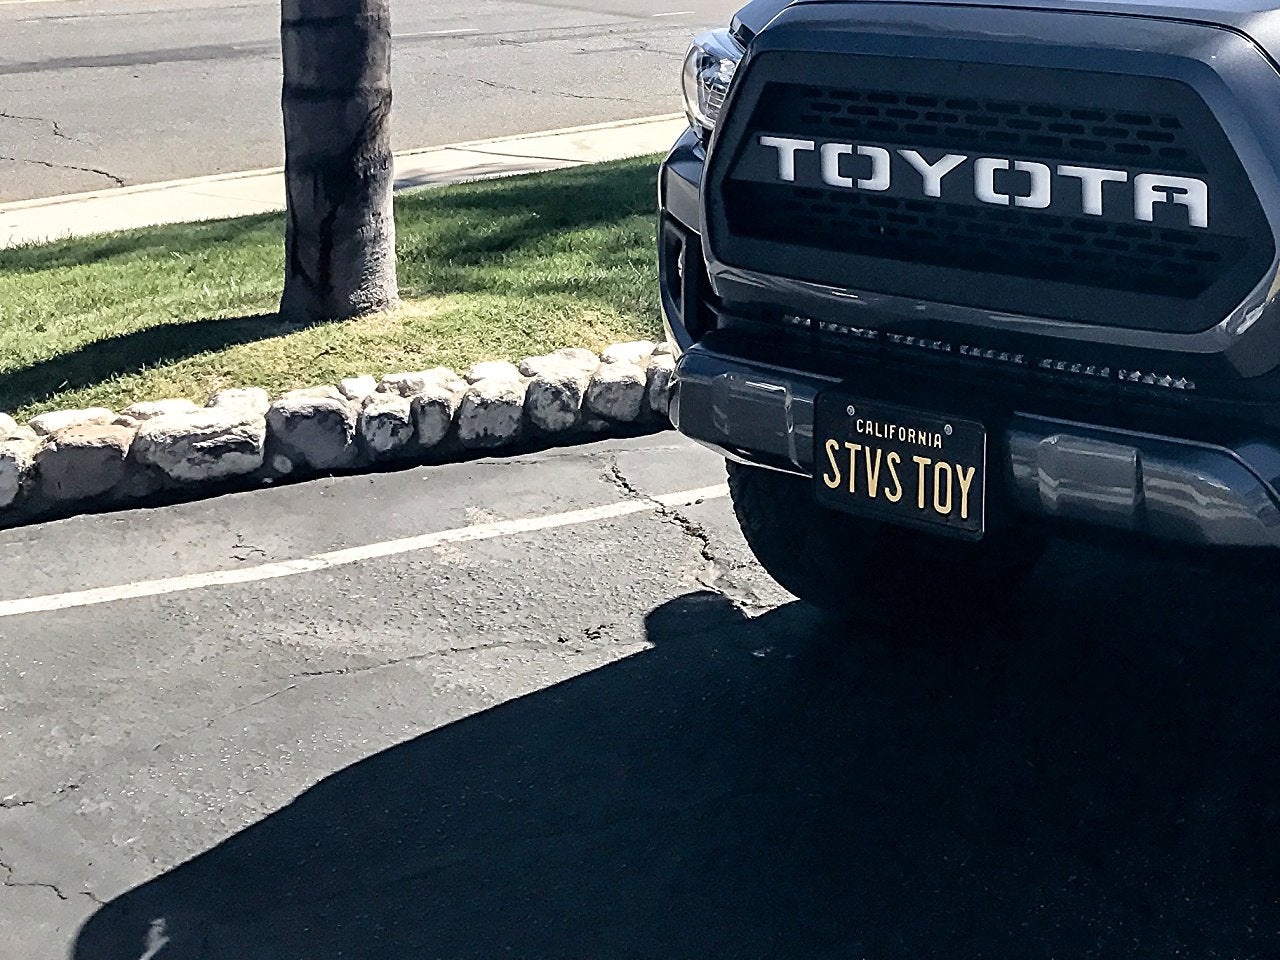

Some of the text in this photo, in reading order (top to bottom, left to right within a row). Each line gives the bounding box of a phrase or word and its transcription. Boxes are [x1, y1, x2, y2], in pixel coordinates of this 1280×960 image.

[759, 135, 1208, 229] TOYOTA
[856, 418, 943, 449] CALIFORNIA
[823, 439, 976, 519] STVS TOY
